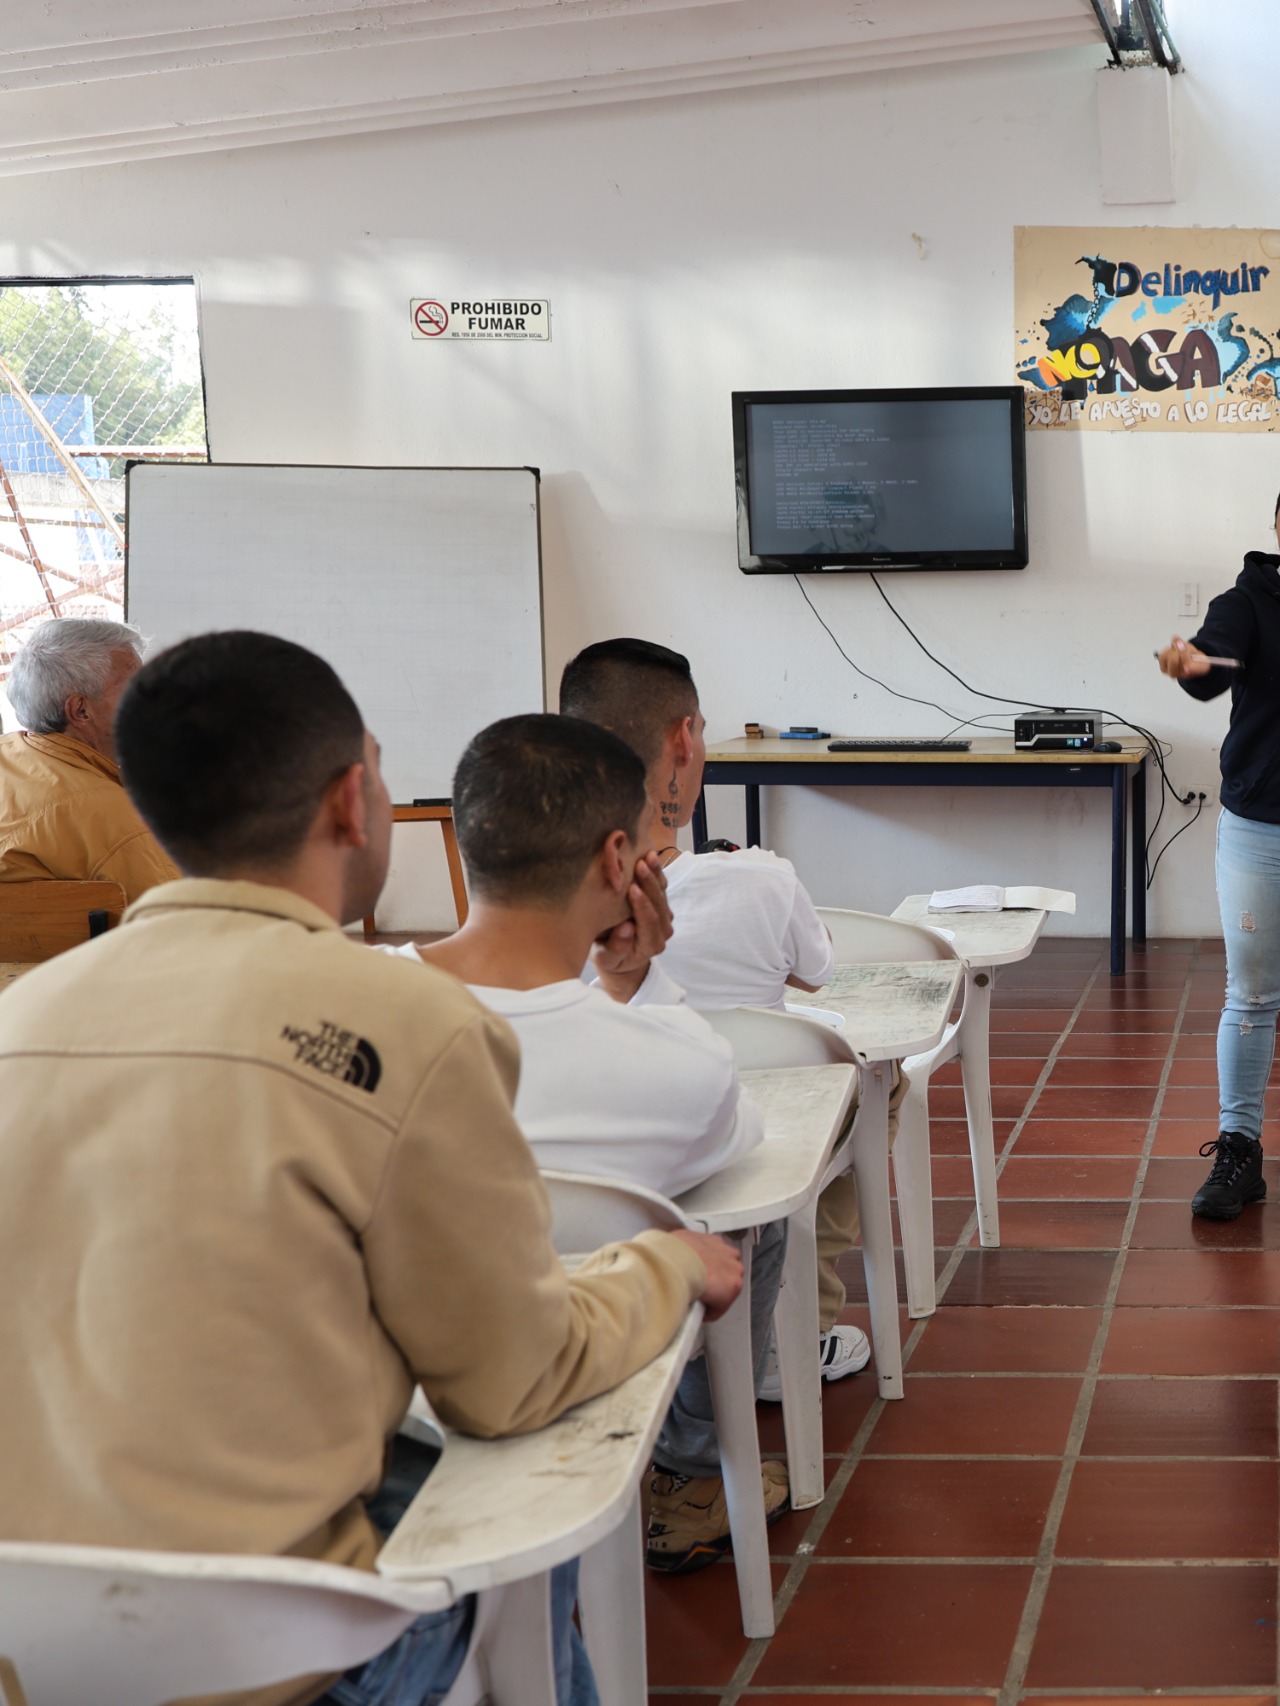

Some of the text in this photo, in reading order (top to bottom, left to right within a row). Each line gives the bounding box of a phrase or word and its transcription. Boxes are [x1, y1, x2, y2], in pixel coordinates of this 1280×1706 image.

[1115, 262, 1270, 311] Delinquir
[451, 302, 542, 315] PROHIBIDO
[468, 317, 526, 330] FUMAR
[1028, 404, 1053, 426] YO
[1060, 401, 1080, 422] LE
[1089, 398, 1162, 422] APUESTO
[1167, 404, 1180, 422] A
[1184, 401, 1209, 423] LO
[280, 1026, 353, 1062] NORTH
[319, 1020, 352, 1045] THE
[295, 1042, 343, 1078] FACE
